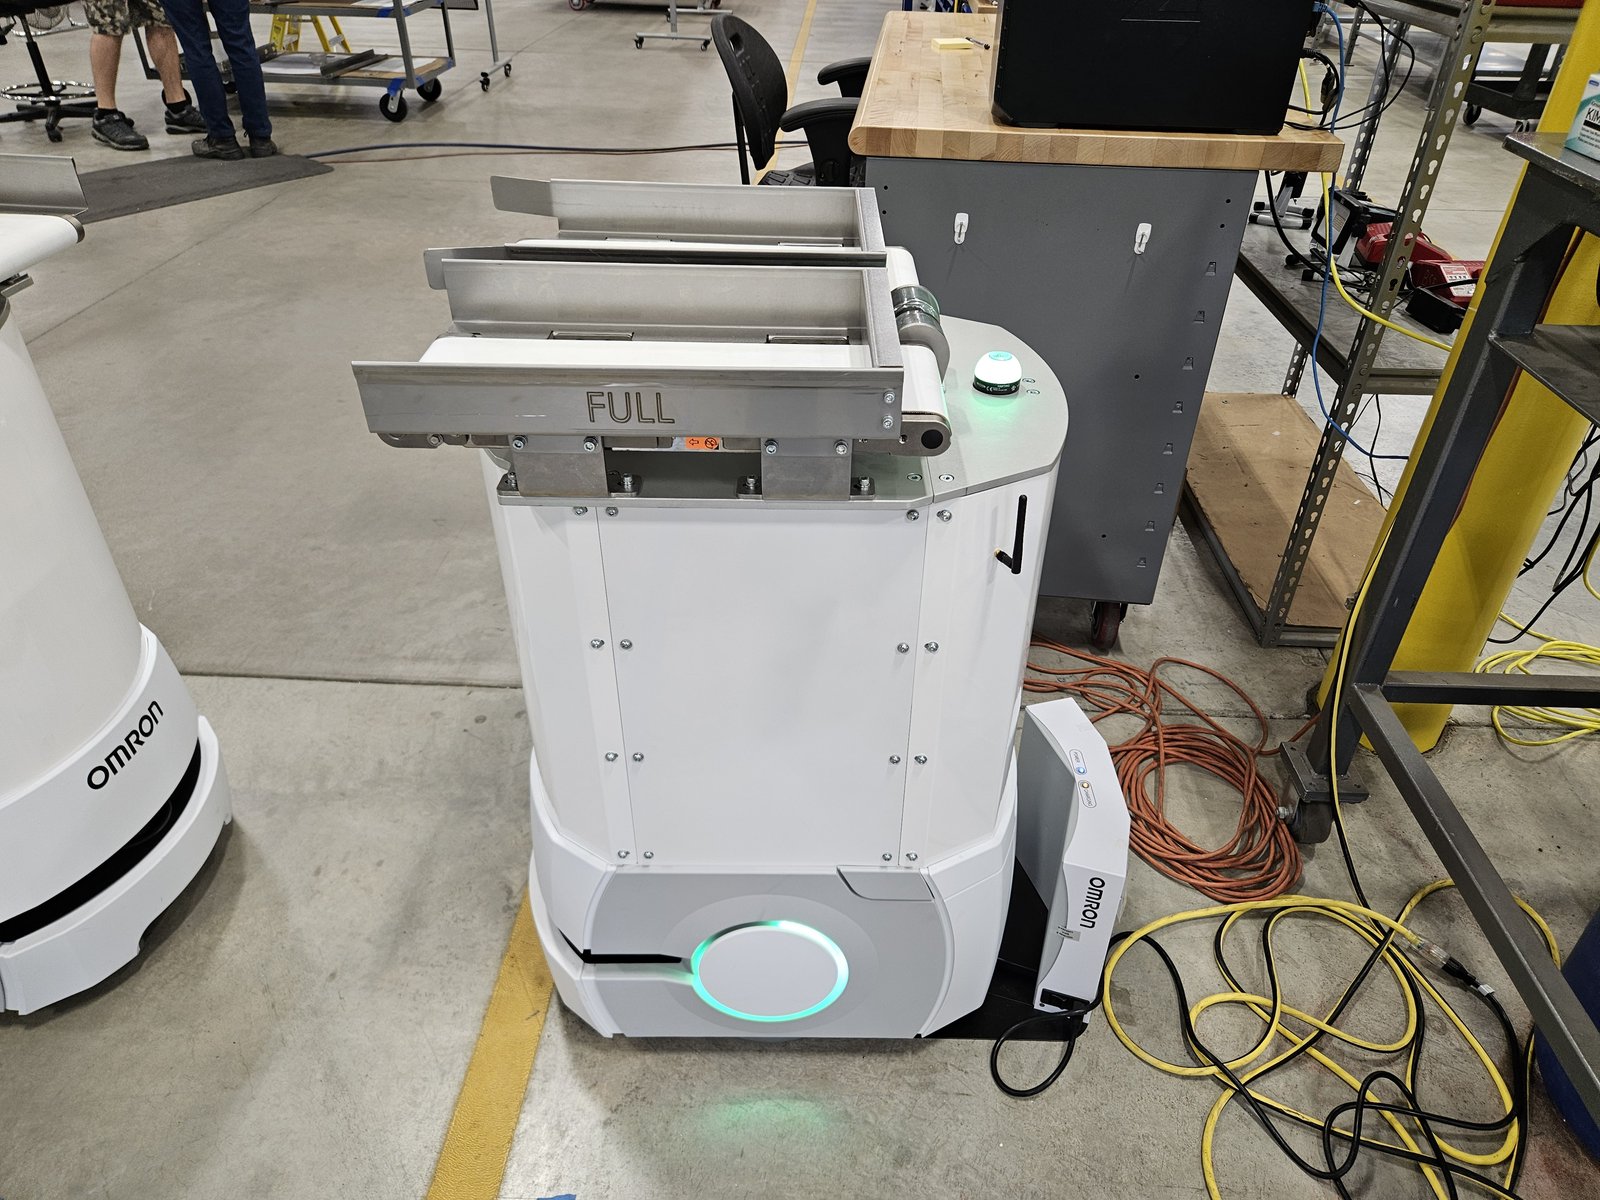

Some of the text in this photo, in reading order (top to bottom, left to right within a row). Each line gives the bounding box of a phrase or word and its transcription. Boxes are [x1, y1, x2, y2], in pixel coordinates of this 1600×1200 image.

[586, 391, 675, 424] FULL
[87, 701, 164, 790] OMRON
[1079, 877, 1106, 929] OMRON
